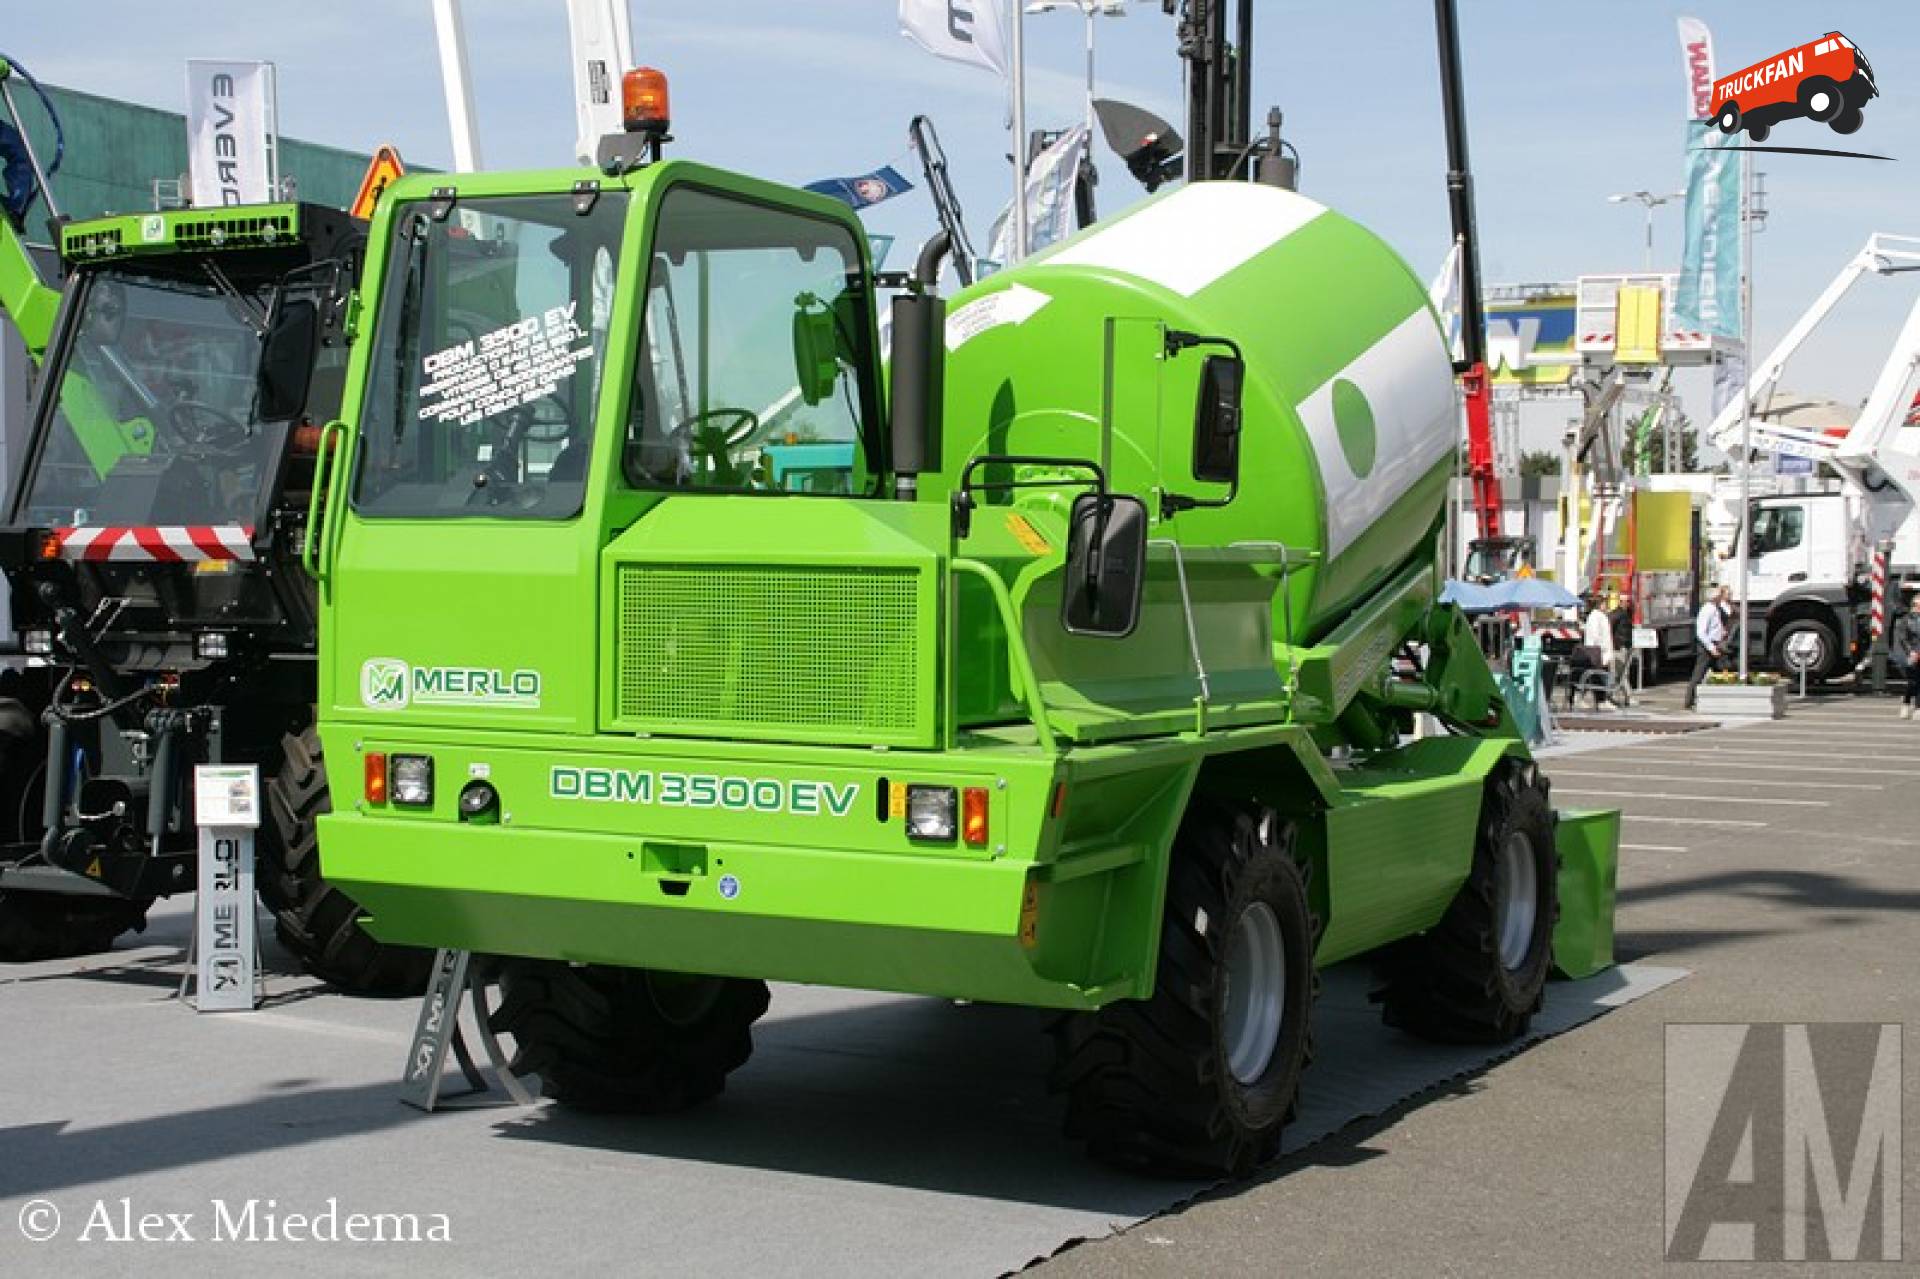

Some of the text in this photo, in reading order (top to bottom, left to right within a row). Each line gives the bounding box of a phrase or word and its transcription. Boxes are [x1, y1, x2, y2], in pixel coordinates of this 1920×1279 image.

[424, 340, 474, 372] DBM
[480, 317, 538, 348] 3500
[545, 301, 576, 327] EV
[413, 668, 540, 696] MERLO
[552, 767, 859, 815] DBM 3500 EV
